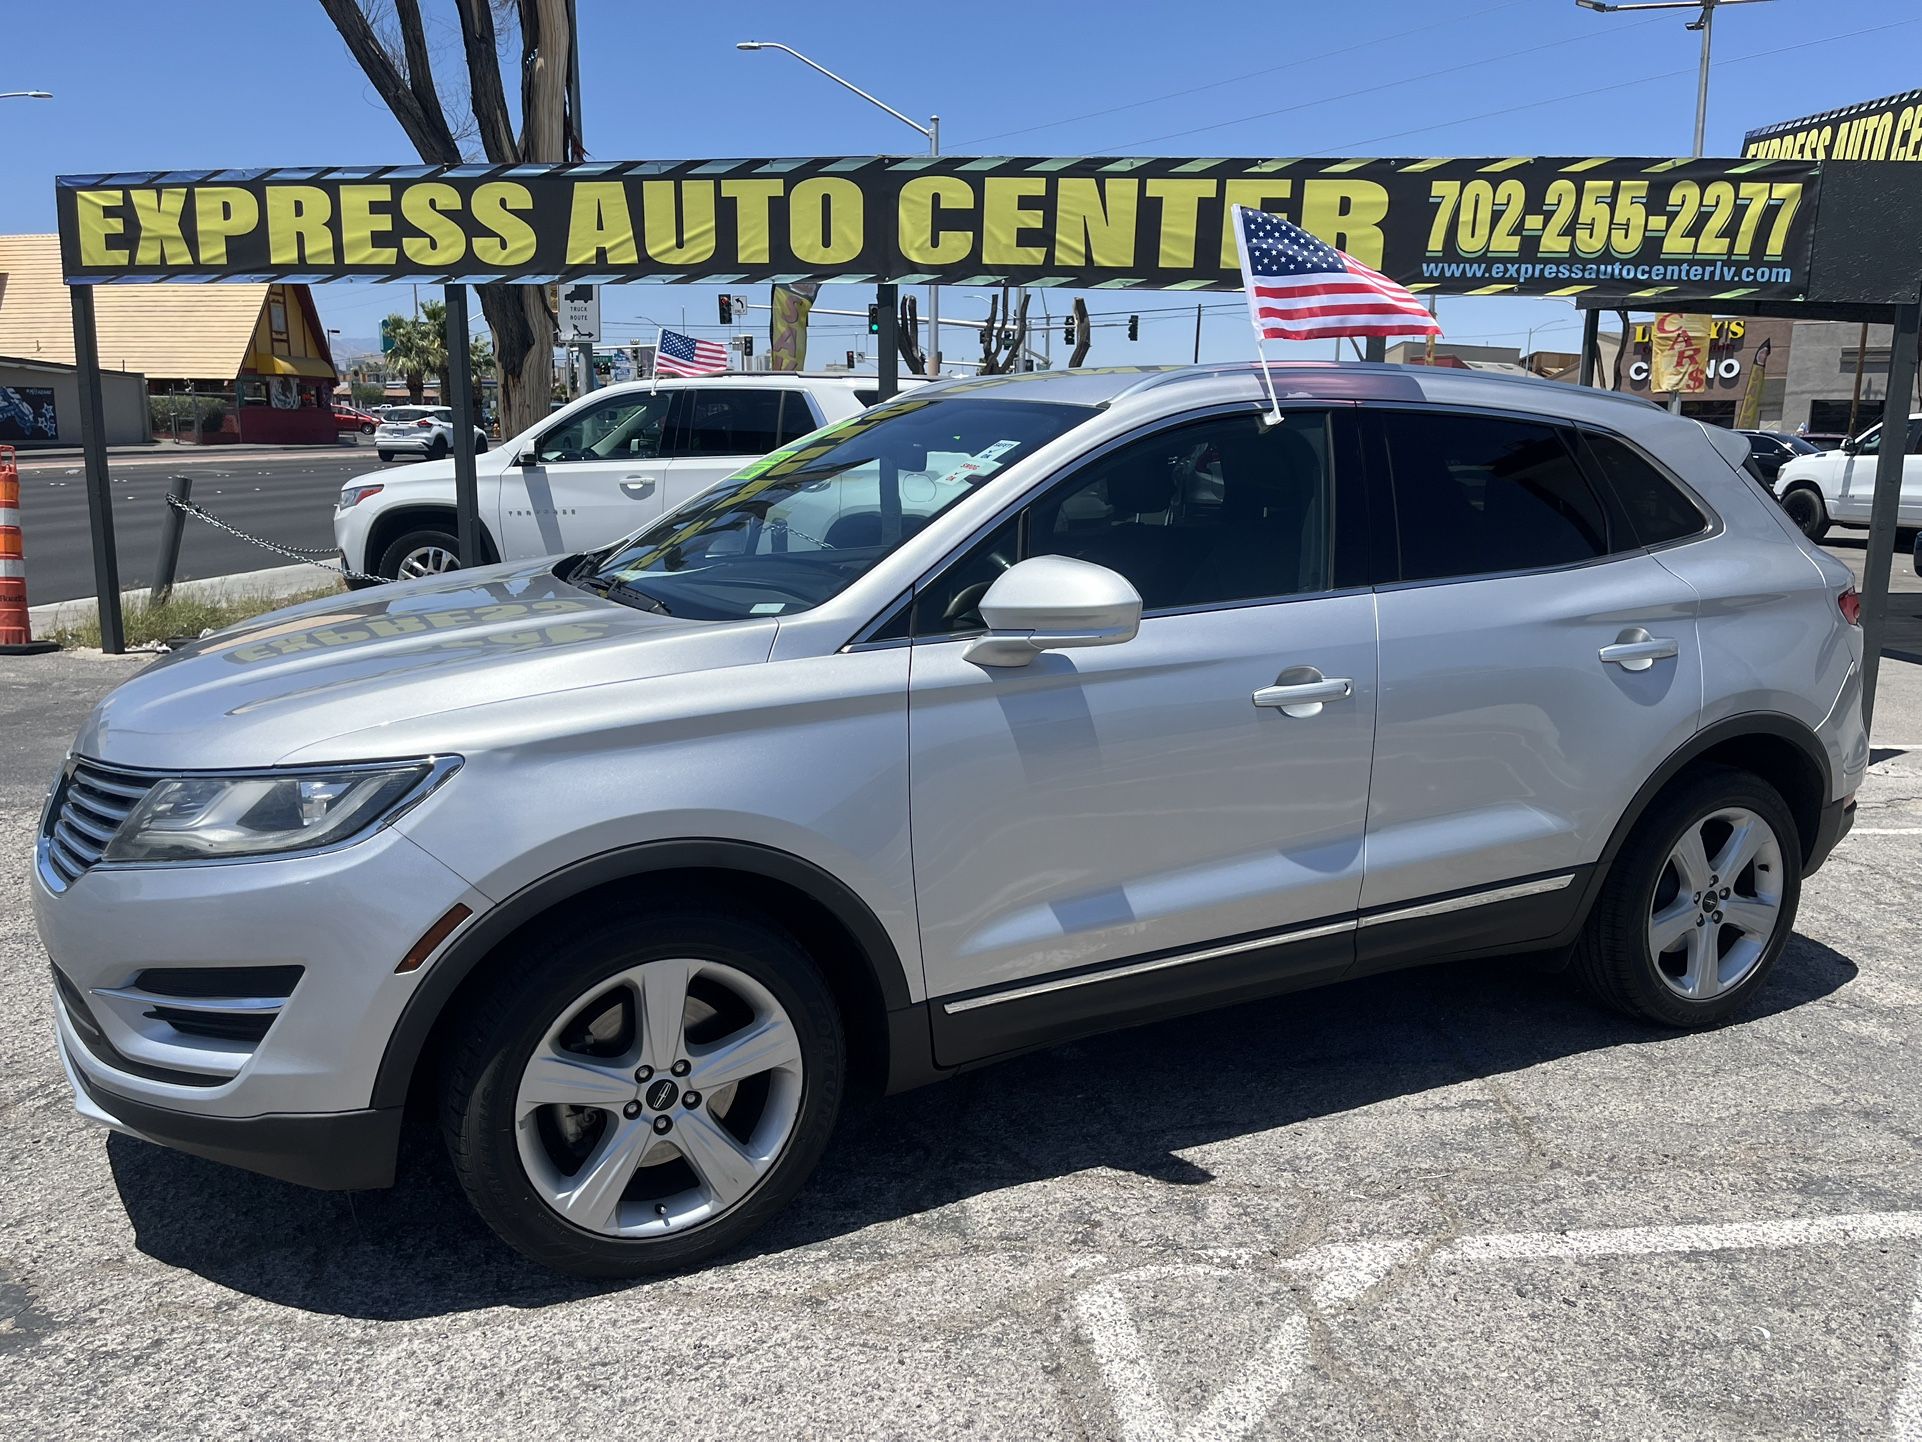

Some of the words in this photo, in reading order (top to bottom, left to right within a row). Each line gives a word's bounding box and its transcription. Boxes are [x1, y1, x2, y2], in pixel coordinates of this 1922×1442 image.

[76, 181, 537, 266] EXPRESS
[565, 176, 864, 264] AUTO
[898, 177, 1389, 271] CENTER
[1425, 179, 1803, 261] 702-255-2277
[1422, 261, 1791, 283] www.expressautocenterlv.com
